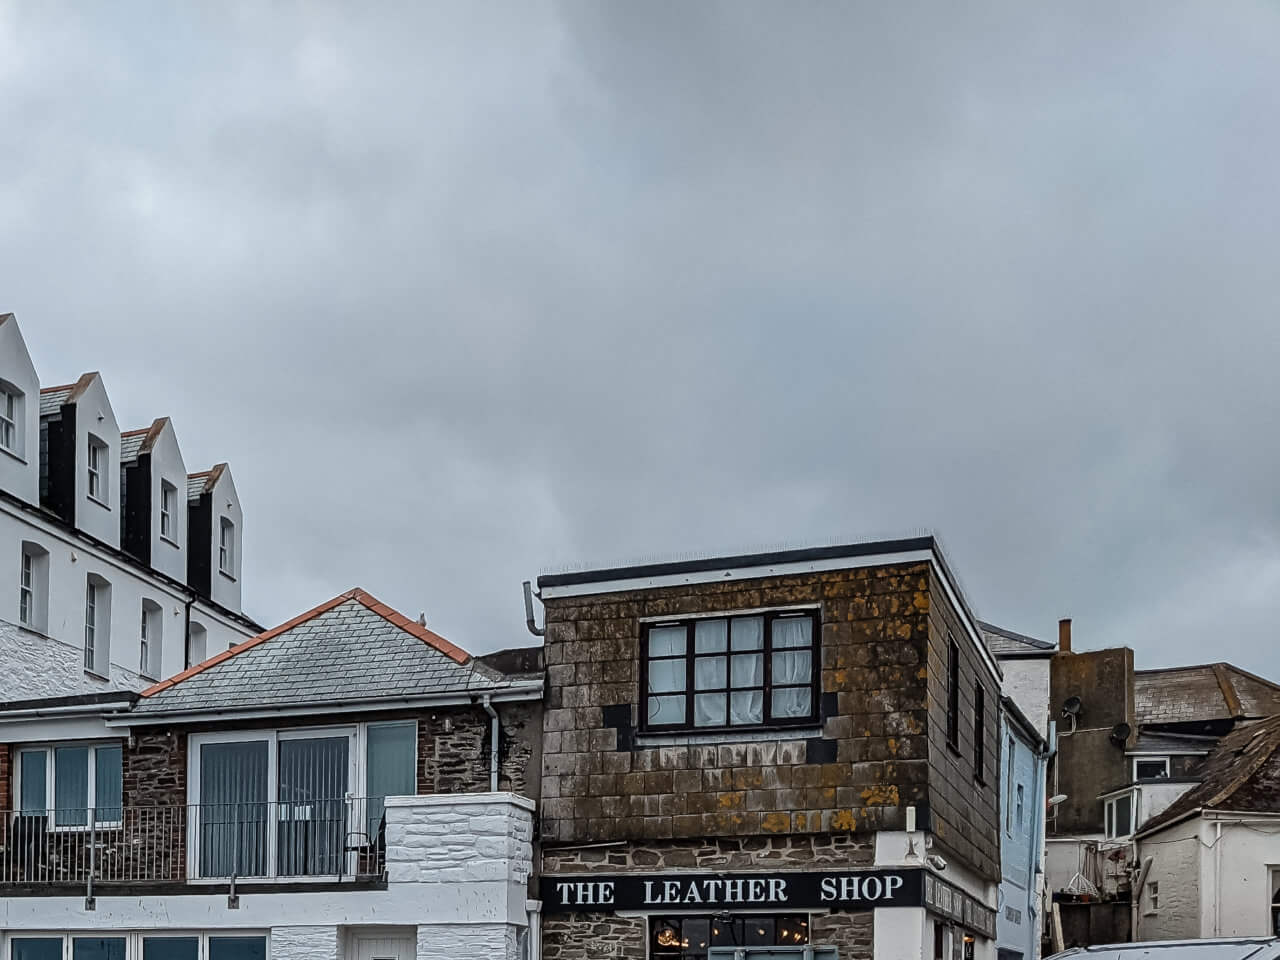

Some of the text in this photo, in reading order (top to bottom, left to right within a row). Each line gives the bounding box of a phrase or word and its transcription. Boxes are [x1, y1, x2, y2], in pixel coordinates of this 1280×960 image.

[557, 875, 904, 905] THE LEATHER SHOP
